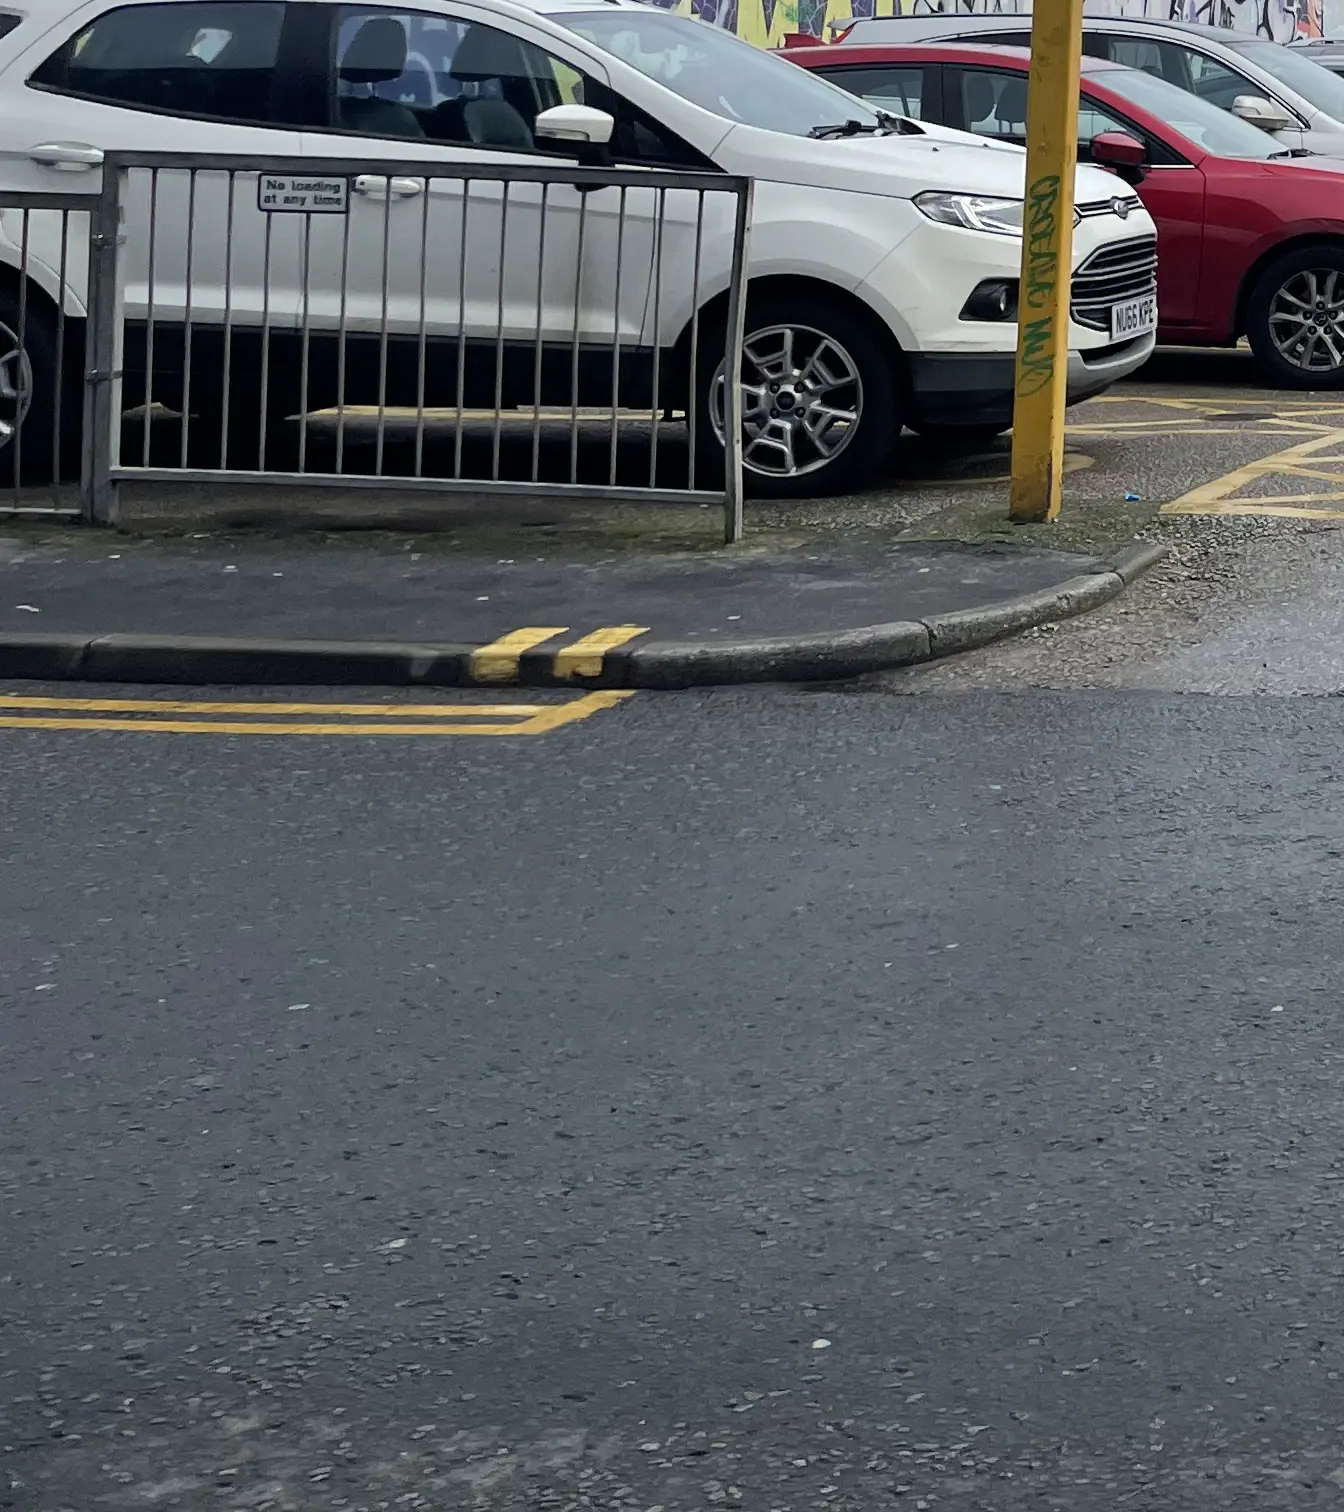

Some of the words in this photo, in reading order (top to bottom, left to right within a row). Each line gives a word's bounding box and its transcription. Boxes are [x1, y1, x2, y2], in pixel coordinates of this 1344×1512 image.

[266, 179, 286, 191] No
[291, 180, 341, 194] loading
[264, 194, 277, 204] at
[283, 196, 307, 207] any
[313, 194, 343, 205] time
